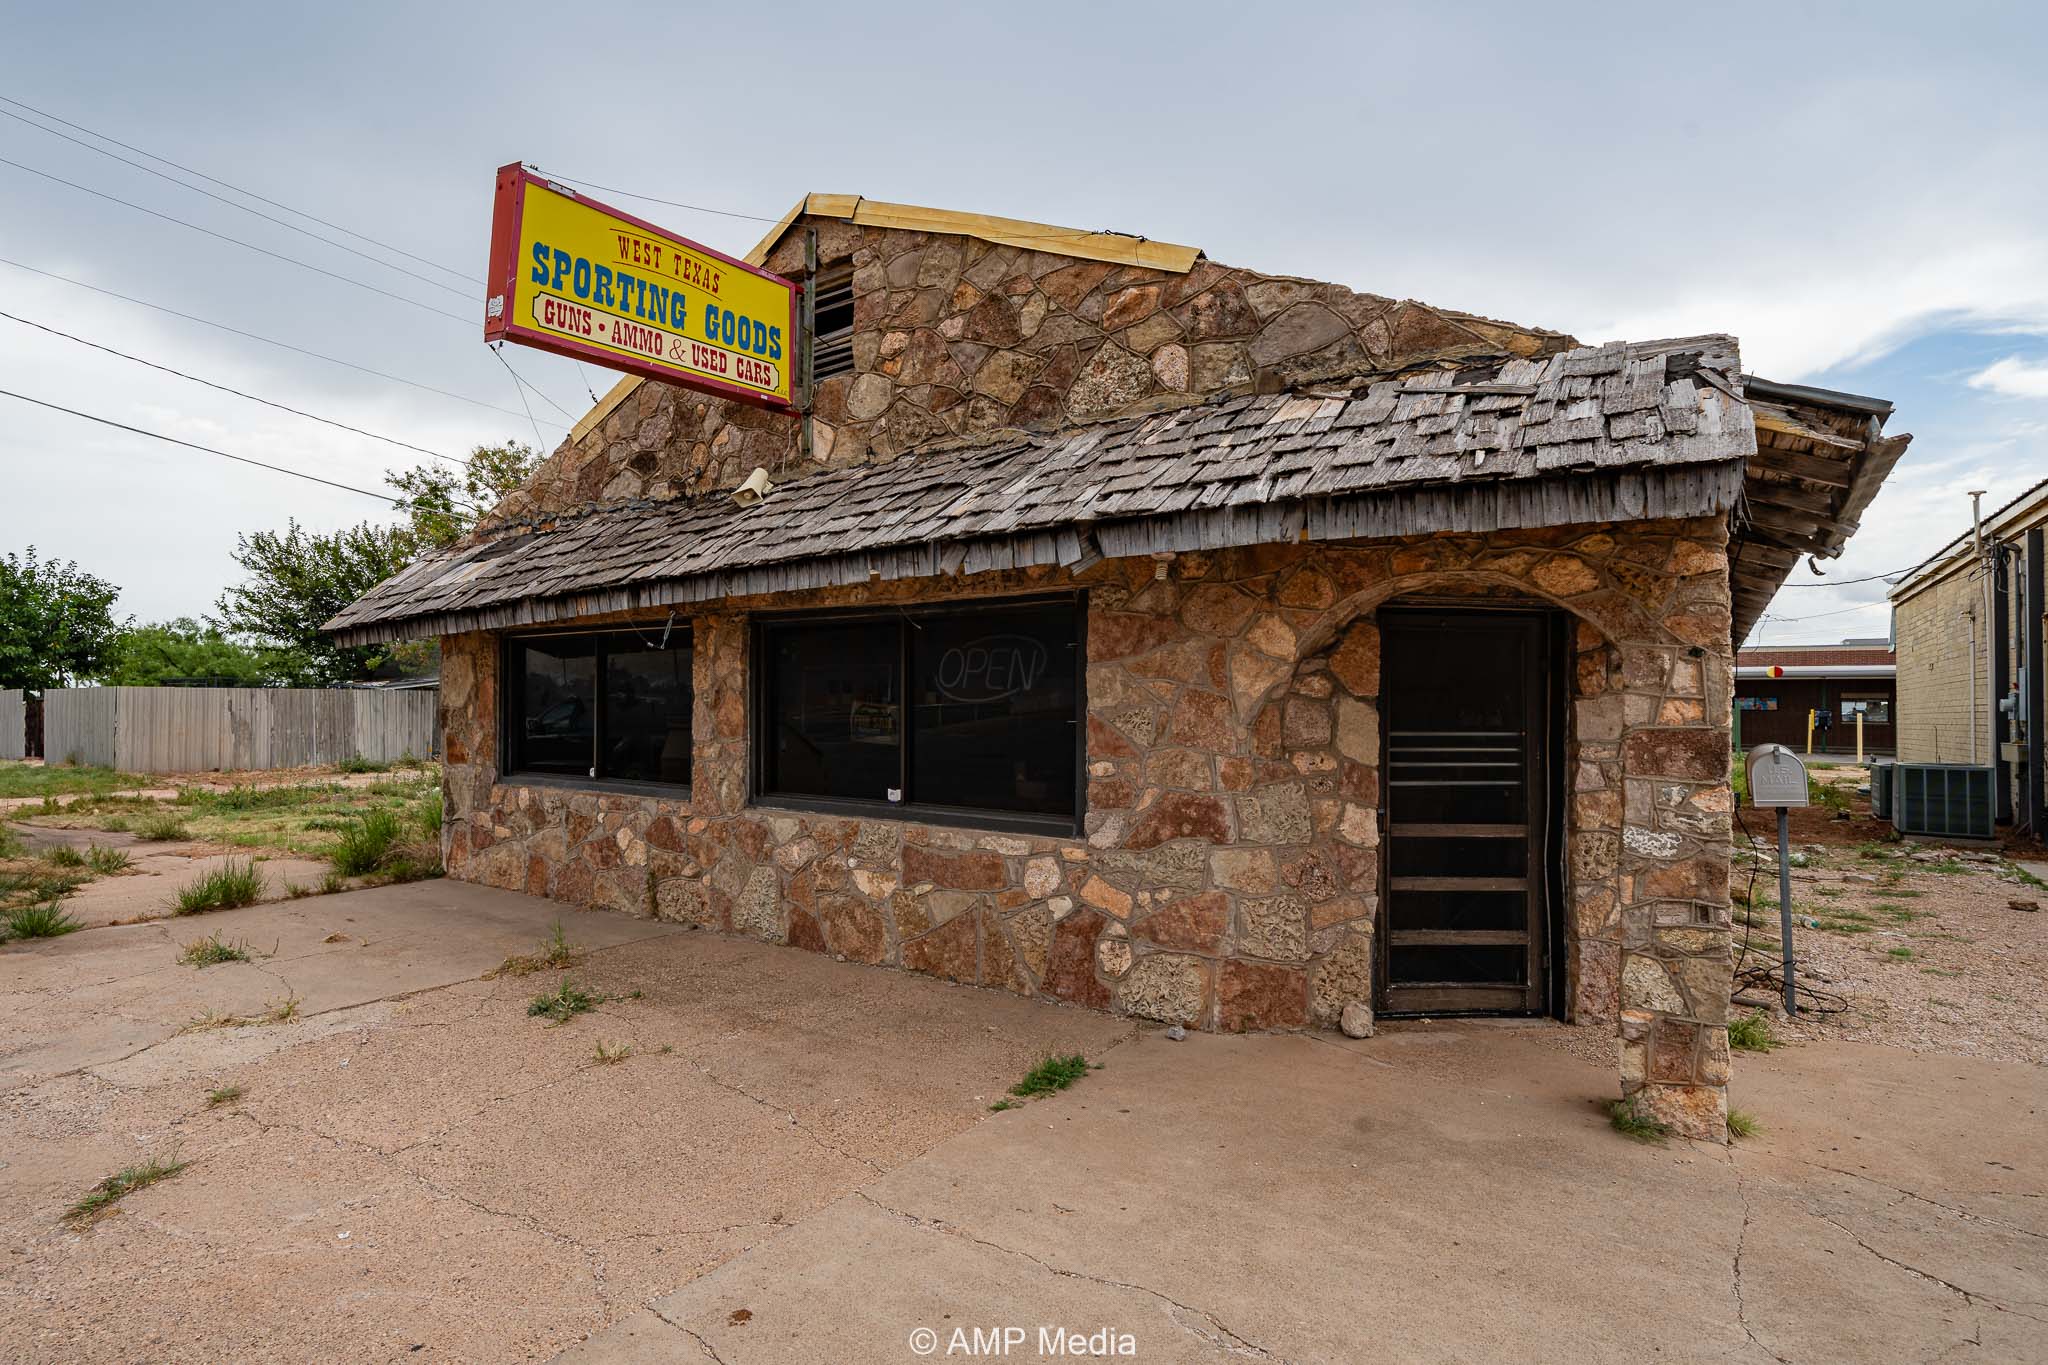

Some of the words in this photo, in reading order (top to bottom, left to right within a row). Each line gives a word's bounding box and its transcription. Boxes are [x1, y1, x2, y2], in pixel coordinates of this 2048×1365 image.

[617, 235, 661, 269] WEST
[674, 254, 720, 293] TEXAS
[531, 241, 687, 330] SPORTING
[705, 304, 782, 360] GOODS
[544, 299, 592, 336] GUNS
[611, 320, 663, 356] AMMO
[669, 338, 687, 362] &
[691, 343, 727, 374] USED
[736, 357, 771, 387] CARS
[938, 647, 1038, 691] OPEN
[1760, 775, 1800, 785] MAIL
